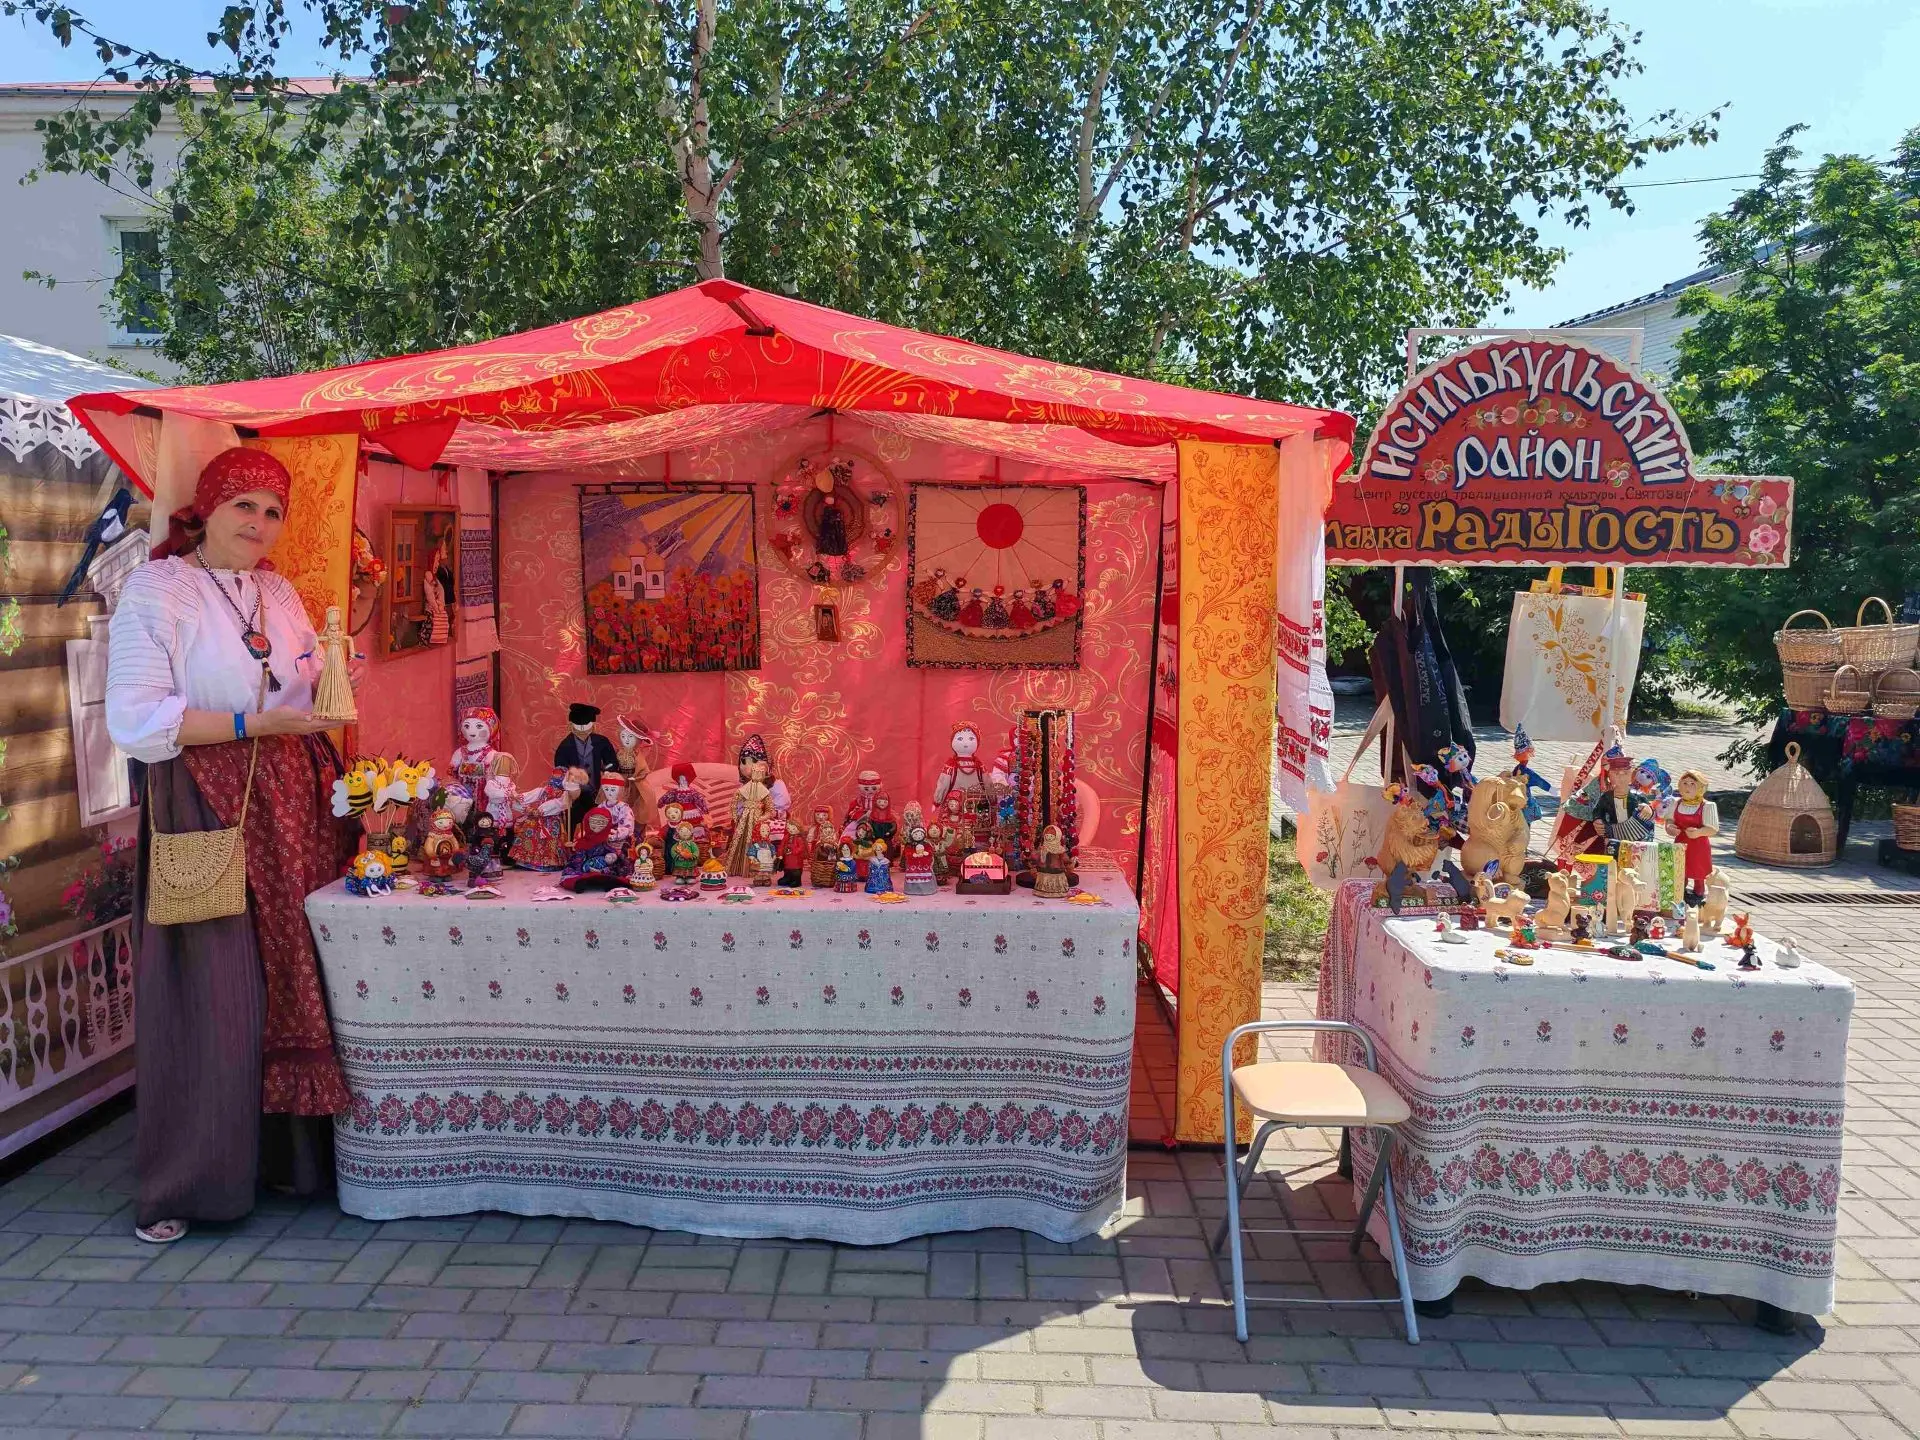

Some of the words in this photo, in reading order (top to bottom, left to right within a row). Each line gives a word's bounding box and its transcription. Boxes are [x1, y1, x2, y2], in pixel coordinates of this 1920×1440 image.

[1353, 488, 1392, 501] Центр
[1399, 487, 1448, 501] русской
[1455, 489, 1553, 502] традиционной
[1559, 490, 1617, 501] культуры
